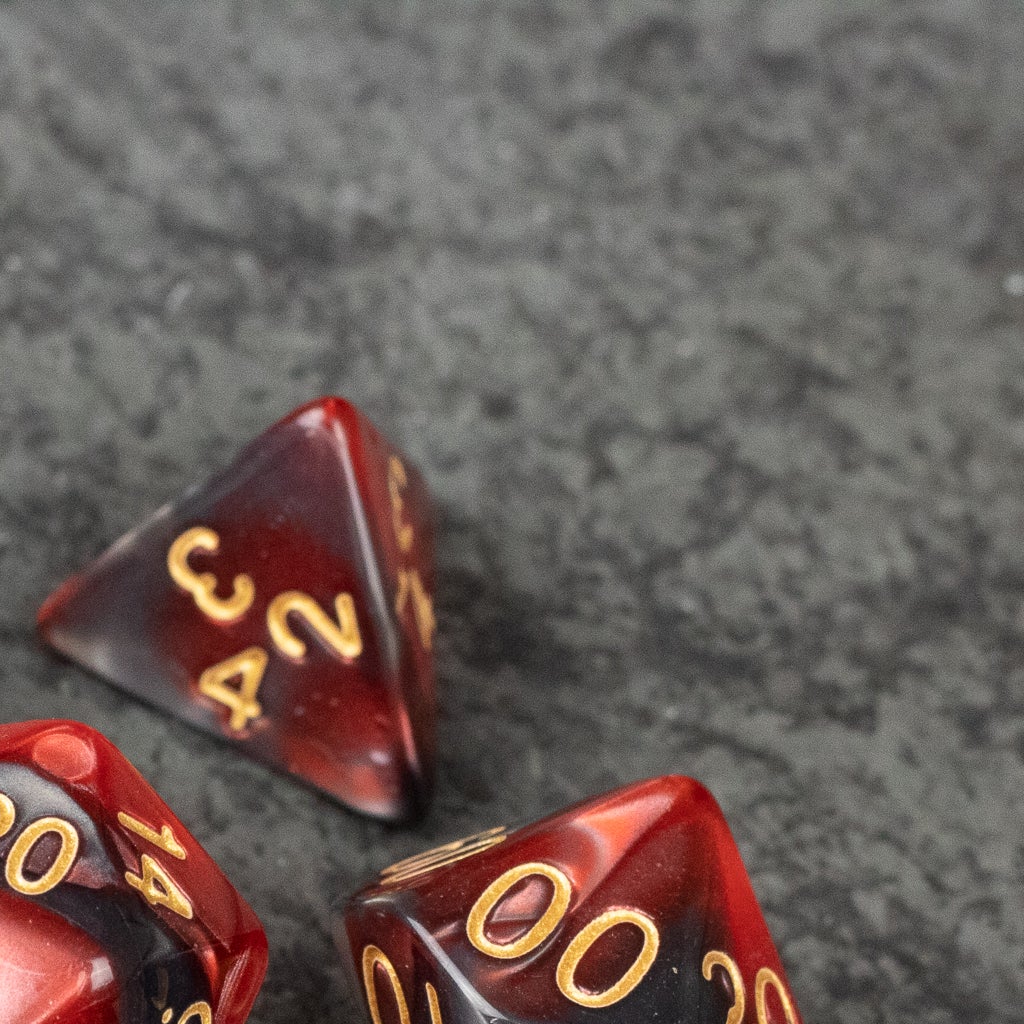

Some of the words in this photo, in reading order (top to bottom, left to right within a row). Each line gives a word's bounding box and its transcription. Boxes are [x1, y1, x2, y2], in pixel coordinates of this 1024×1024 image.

[167, 527, 255, 620] 3
[267, 592, 363, 658] 2
[199, 647, 268, 731] 4
[118, 812, 192, 919] 14
[466, 862, 660, 1008] 00
